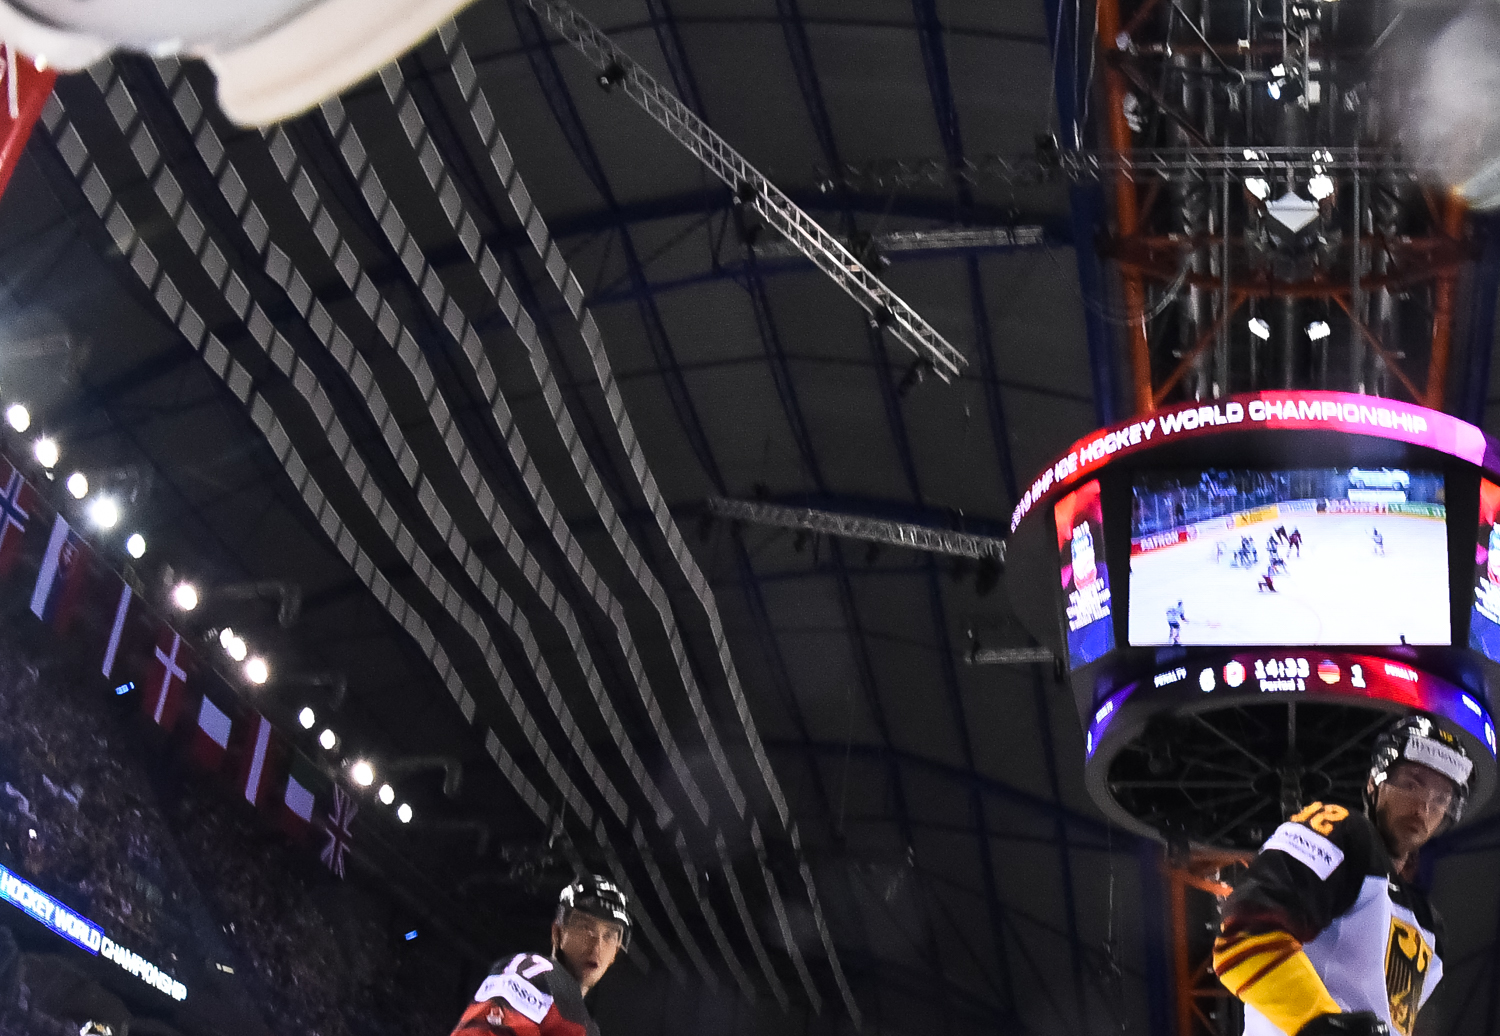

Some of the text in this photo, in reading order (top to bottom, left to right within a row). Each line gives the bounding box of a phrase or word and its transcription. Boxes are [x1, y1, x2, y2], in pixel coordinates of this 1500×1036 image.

[1054, 451, 1079, 483] ICE
[1079, 418, 1156, 466] HOCKEY
[1159, 403, 1244, 435] WORLD
[1249, 399, 1428, 434] CHAMPIONSHIP
[1254, 658, 1310, 680] 14:33
[1351, 664, 1366, 688] 1
[1, 871, 188, 1001] HOCKEY WORLD CHAMPIONSHIP
